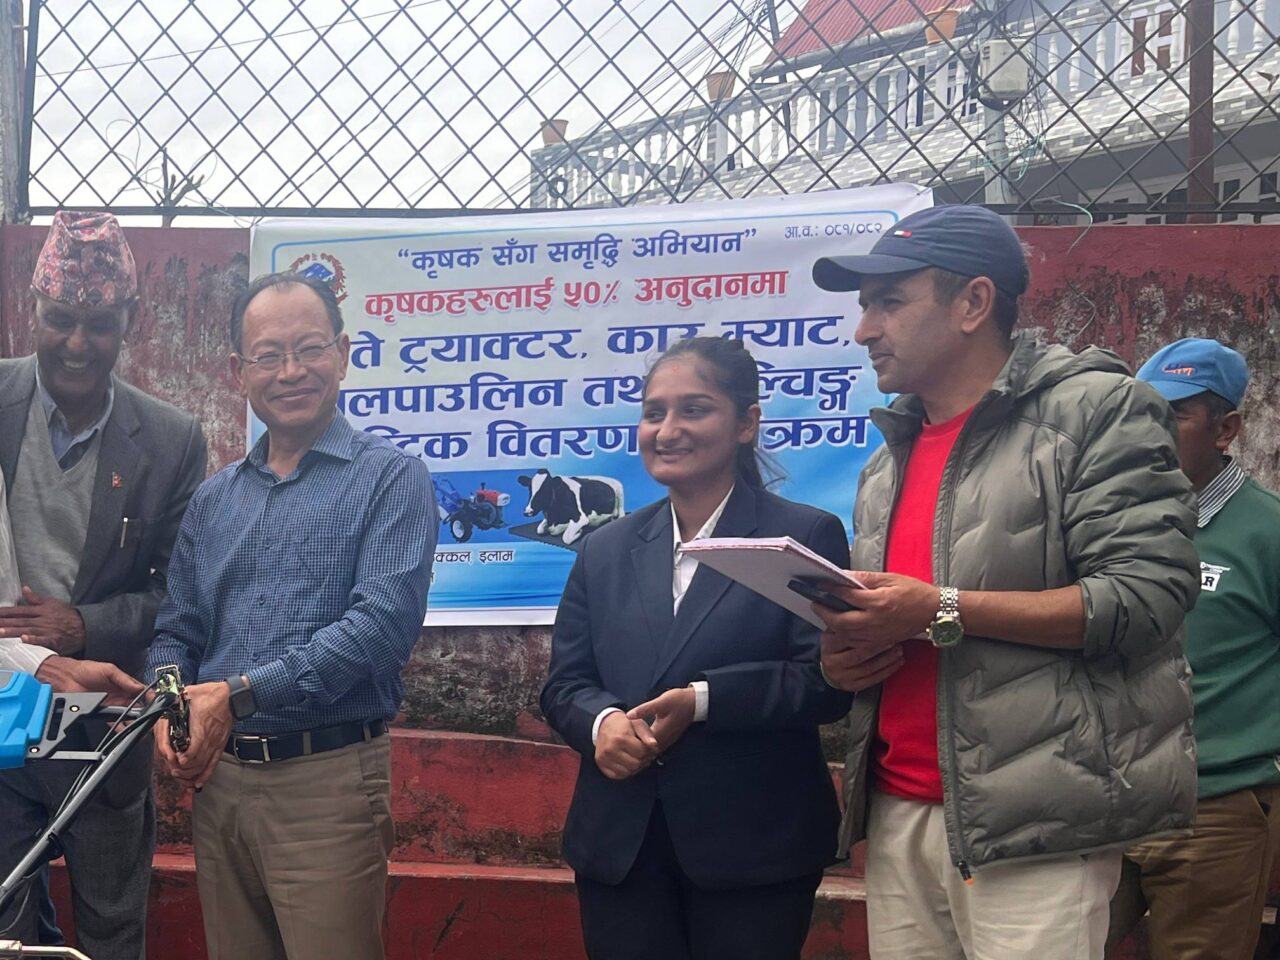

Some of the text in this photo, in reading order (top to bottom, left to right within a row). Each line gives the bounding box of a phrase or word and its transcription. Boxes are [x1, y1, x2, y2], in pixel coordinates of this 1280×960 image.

[397, 248, 483, 279] “कृषक
[492, 237, 538, 266] सँग
[632, 228, 757, 258] अभियान”
[634, 270, 789, 308] अनुदानमा
